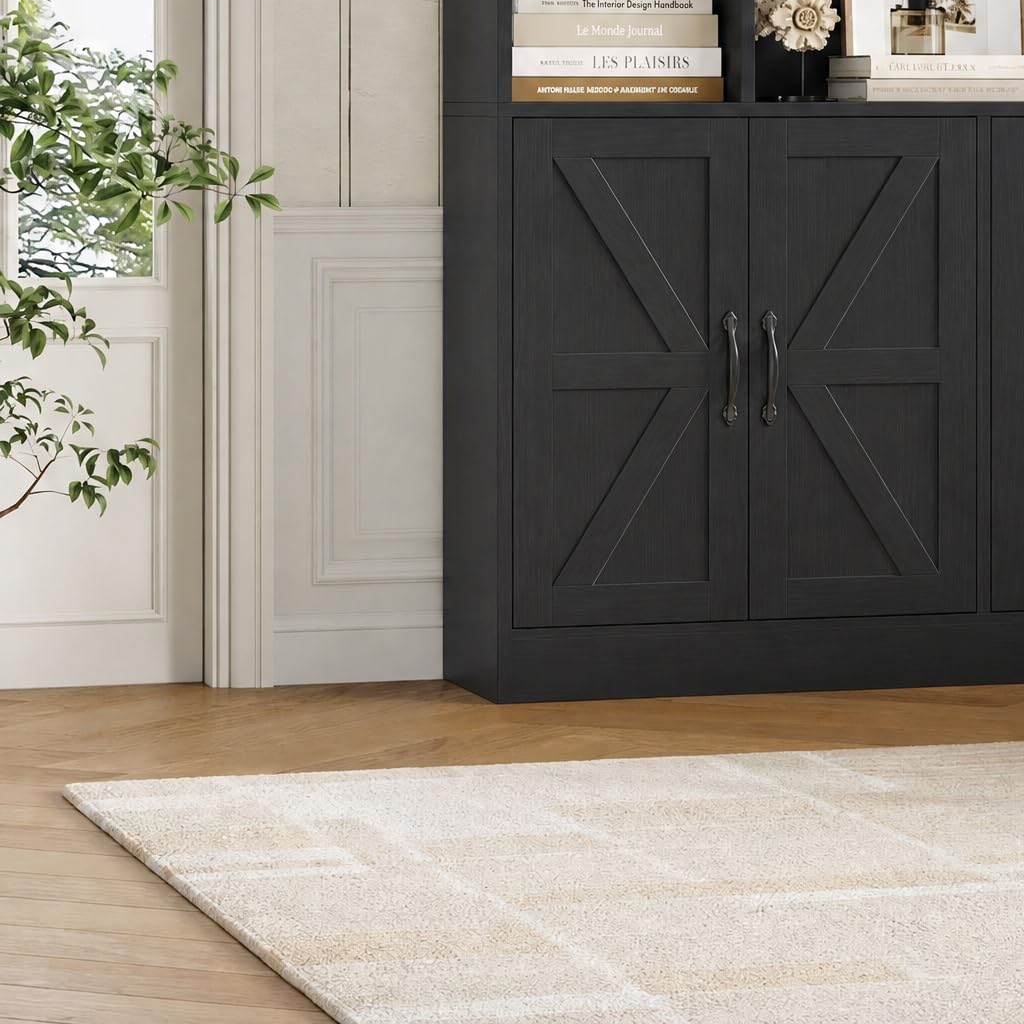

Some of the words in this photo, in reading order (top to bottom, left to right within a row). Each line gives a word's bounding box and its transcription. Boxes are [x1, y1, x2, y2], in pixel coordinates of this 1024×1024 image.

[582, 0, 596, 8] The
[597, 0, 624, 9] Interior
[627, 0, 652, 11] Design
[654, 1, 693, 9] Handbook
[576, 25, 588, 36] Le
[592, 25, 625, 36] Monde
[627, 25, 663, 38] Journal
[593, 55, 619, 69] LES
[624, 55, 690, 69] PLAISIRS
